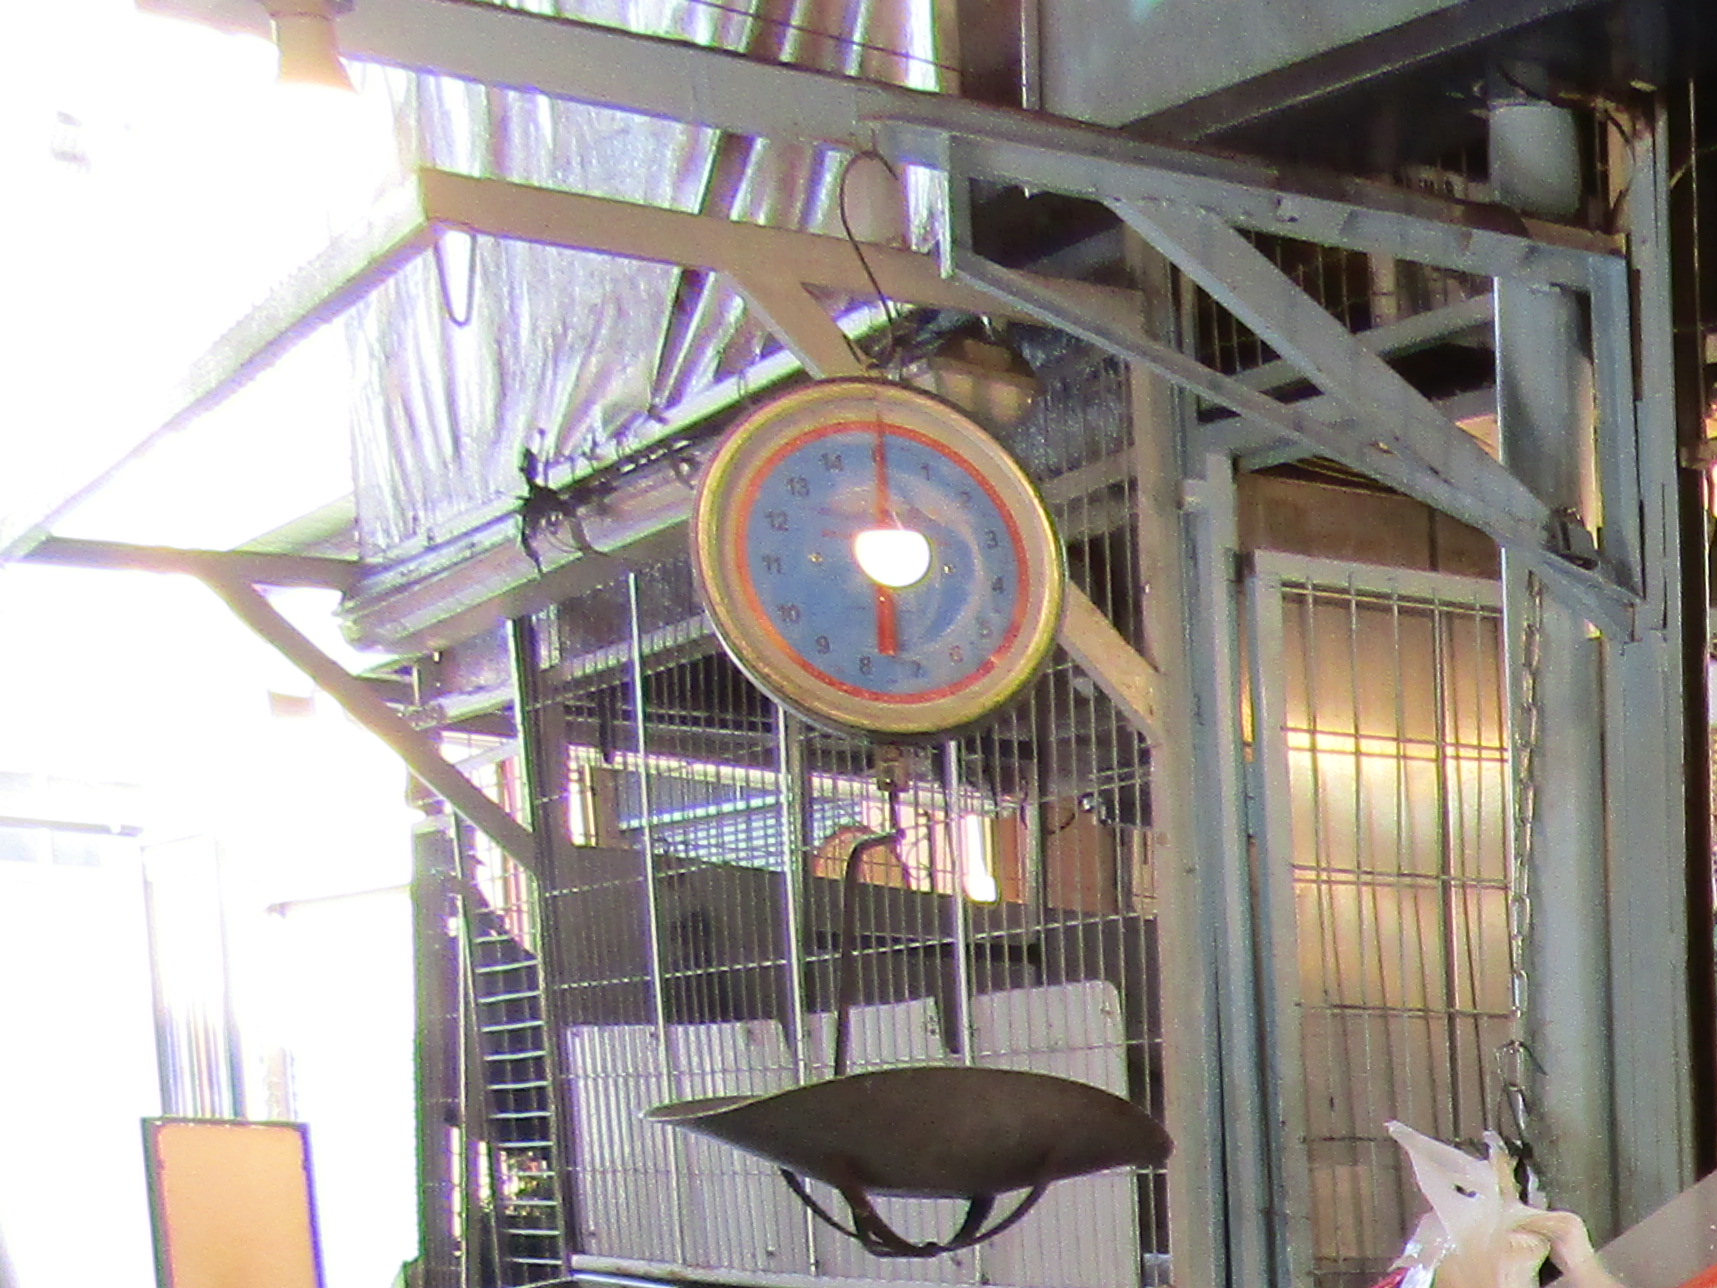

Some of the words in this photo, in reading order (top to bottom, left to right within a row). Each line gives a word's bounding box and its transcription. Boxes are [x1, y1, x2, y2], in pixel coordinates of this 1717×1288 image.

[819, 452, 843, 472] 14
[786, 475, 811, 497] 13
[766, 509, 789, 532] 12
[985, 529, 999, 550] 3
[761, 554, 782, 575] 11
[815, 634, 831, 655] 9
[858, 655, 874, 676] 8
